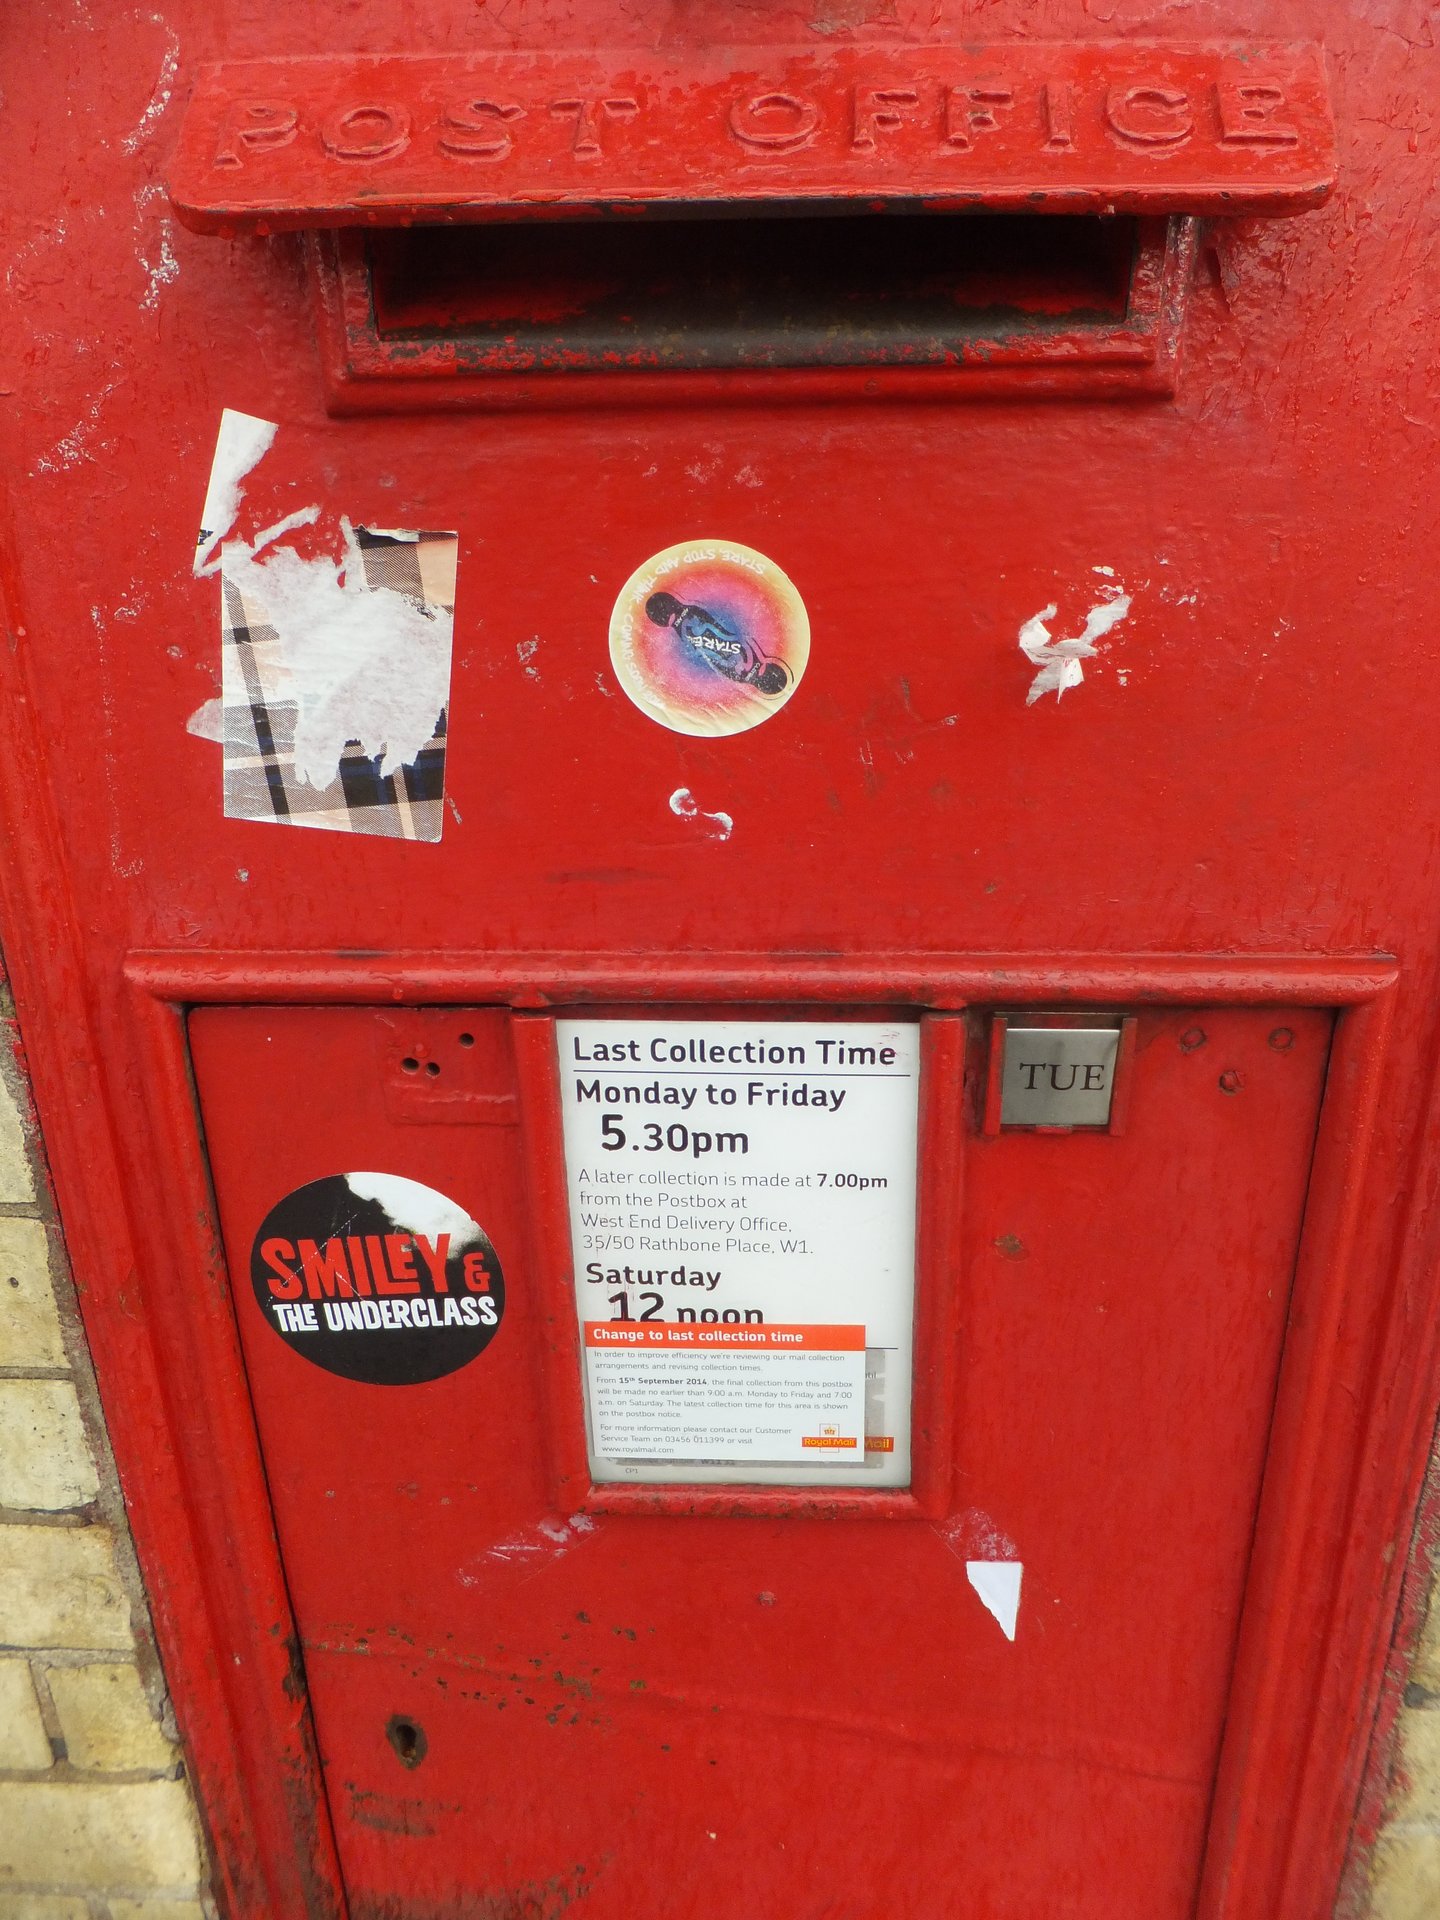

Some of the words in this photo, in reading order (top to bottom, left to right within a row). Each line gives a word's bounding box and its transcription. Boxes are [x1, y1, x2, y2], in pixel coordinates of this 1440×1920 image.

[213, 97, 641, 171] POST
[729, 81, 1299, 153] OFFICE
[656, 556, 680, 575] AND
[684, 550, 716, 564] STOP
[632, 574, 657, 604] THINK
[573, 1036, 641, 1062] Last
[650, 1037, 806, 1065] Collection
[815, 1039, 896, 1066] Time
[1019, 1062, 1105, 1091] TUE
[575, 1079, 697, 1110] Monday
[706, 1085, 737, 1106] to
[747, 1082, 846, 1112] Friday
[601, 1114, 749, 1158] 5.30pm
[578, 1168, 591, 1183] A
[594, 1169, 634, 1185] later
[638, 1170, 719, 1186] collection
[724, 1171, 737, 1187] is
[741, 1172, 790, 1188] made
[794, 1174, 811, 1188] at
[817, 1173, 888, 1191] 7.00pm
[580, 1192, 621, 1207] from
[625, 1193, 653, 1207] the
[658, 1193, 727, 1209] Postbox
[730, 1196, 748, 1209] at
[581, 1214, 624, 1229] West
[629, 1215, 661, 1229] End
[667, 1215, 735, 1234] Delivery
[583, 1235, 634, 1251] 35/50
[640, 1236, 721, 1252] Rathbone
[780, 1240, 814, 1254] W1.
[260, 1232, 452, 1300] SMILEY
[463, 1252, 491, 1292] &
[585, 1263, 721, 1291] Saturday
[273, 1303, 319, 1332] THE
[323, 1296, 498, 1332] UNDERCLASS
[607, 1291, 665, 1323] 12
[676, 1306, 764, 1324] noon
[593, 1328, 644, 1342] Change
[649, 1330, 663, 1340] to
[668, 1330, 694, 1341] last
[698, 1331, 766, 1342] collection
[771, 1331, 803, 1342] time
[637, 1352, 668, 1360] improve
[671, 1352, 707, 1361] efficiency
[733, 1353, 770, 1362] reviewing
[808, 1354, 845, 1362] collection
[595, 1363, 649, 1371] arrangements
[668, 1364, 699, 1372] revising
[596, 1376, 617, 1384] From
[638, 1377, 684, 1387] September
[746, 1379, 781, 1387] collection
[784, 1379, 803, 1387] from
[822, 1381, 853, 1389] postbox
[747, 1391, 778, 1399] Monday
[790, 1391, 814, 1400] Friday
[626, 1411, 655, 1419] postbox
[684, 1400, 705, 1408] latest
[822, 1403, 848, 1411] shown
[600, 1434, 629, 1442] Service
[693, 1436, 725, 1444] 011399
[637, 1425, 680, 1433] information
[683, 1425, 707, 1434] please
[710, 1426, 737, 1434] contact
[602, 1446, 674, 1454] www.royalmail.com
[804, 1437, 832, 1447] Royal
[832, 1437, 855, 1447] Mail
